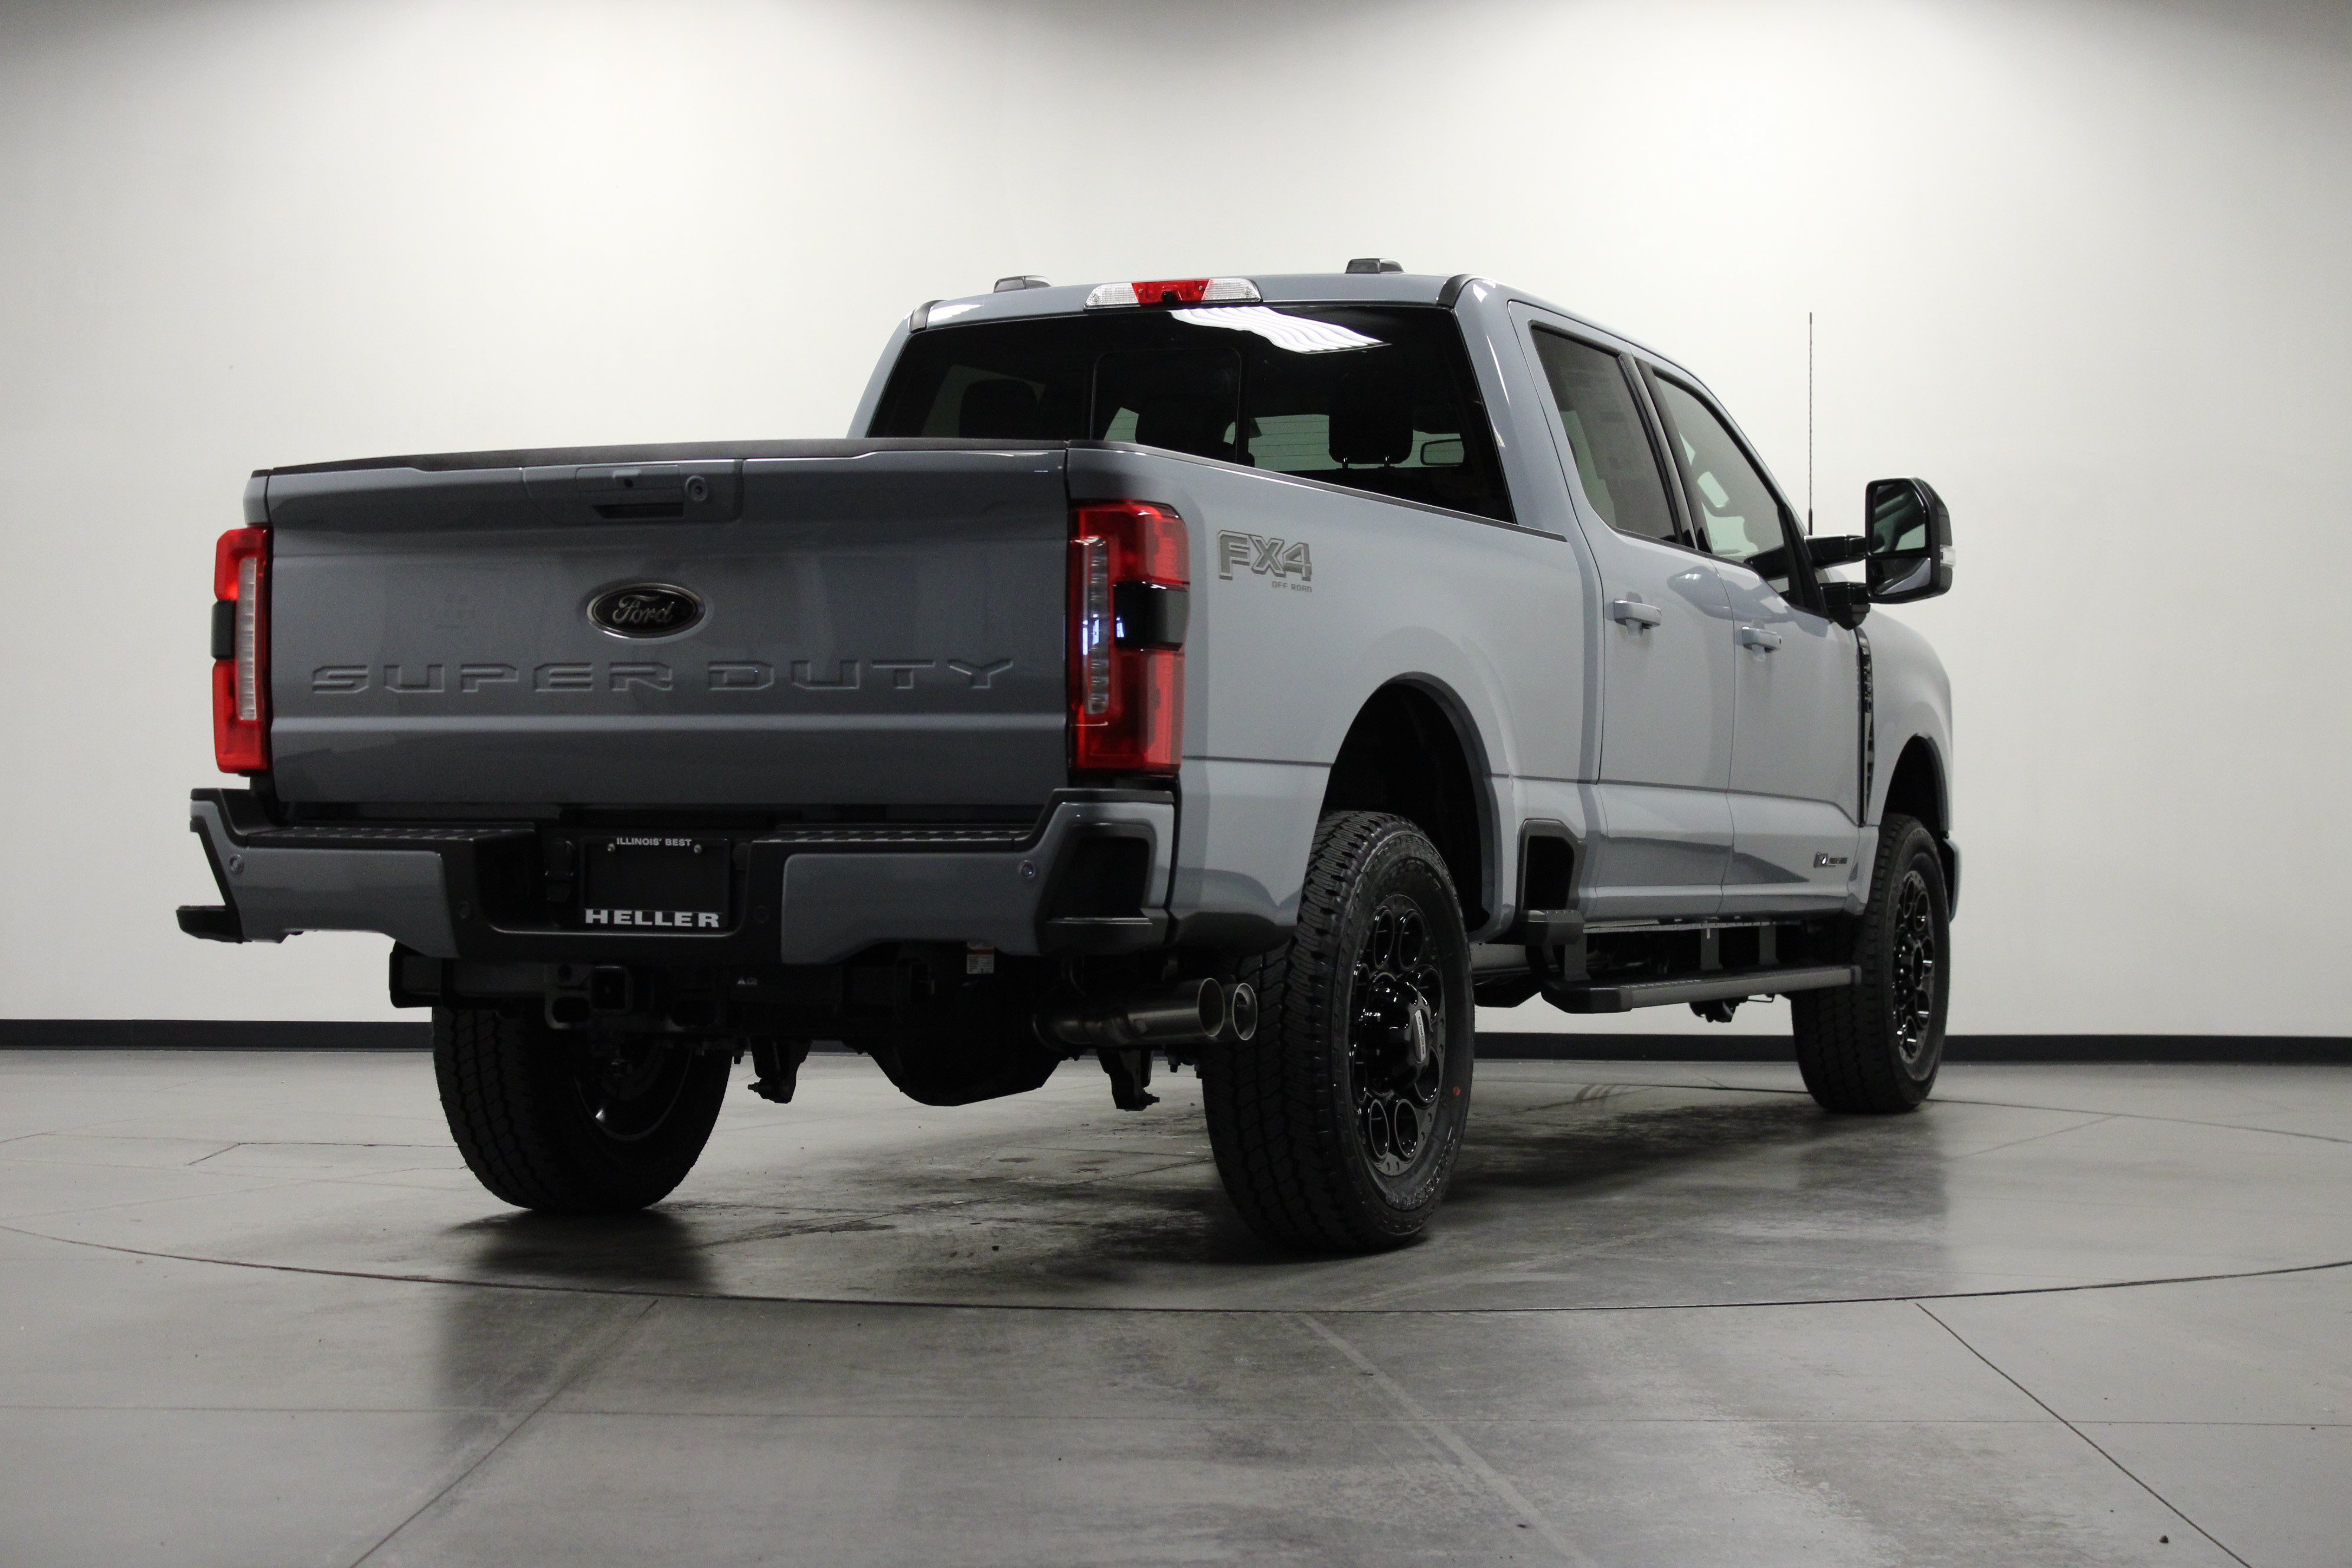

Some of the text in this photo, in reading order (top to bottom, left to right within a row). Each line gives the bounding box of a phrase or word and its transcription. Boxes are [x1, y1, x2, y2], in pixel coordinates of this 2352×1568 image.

[1217, 529, 1312, 582] FX4
[1272, 581, 1312, 593] OFF ROAD
[612, 594, 675, 625] Ford
[312, 658, 1014, 695] SUPER DUTY
[616, 837, 692, 847] ILLINOIS' BEST
[585, 909, 719, 927] HELLER
